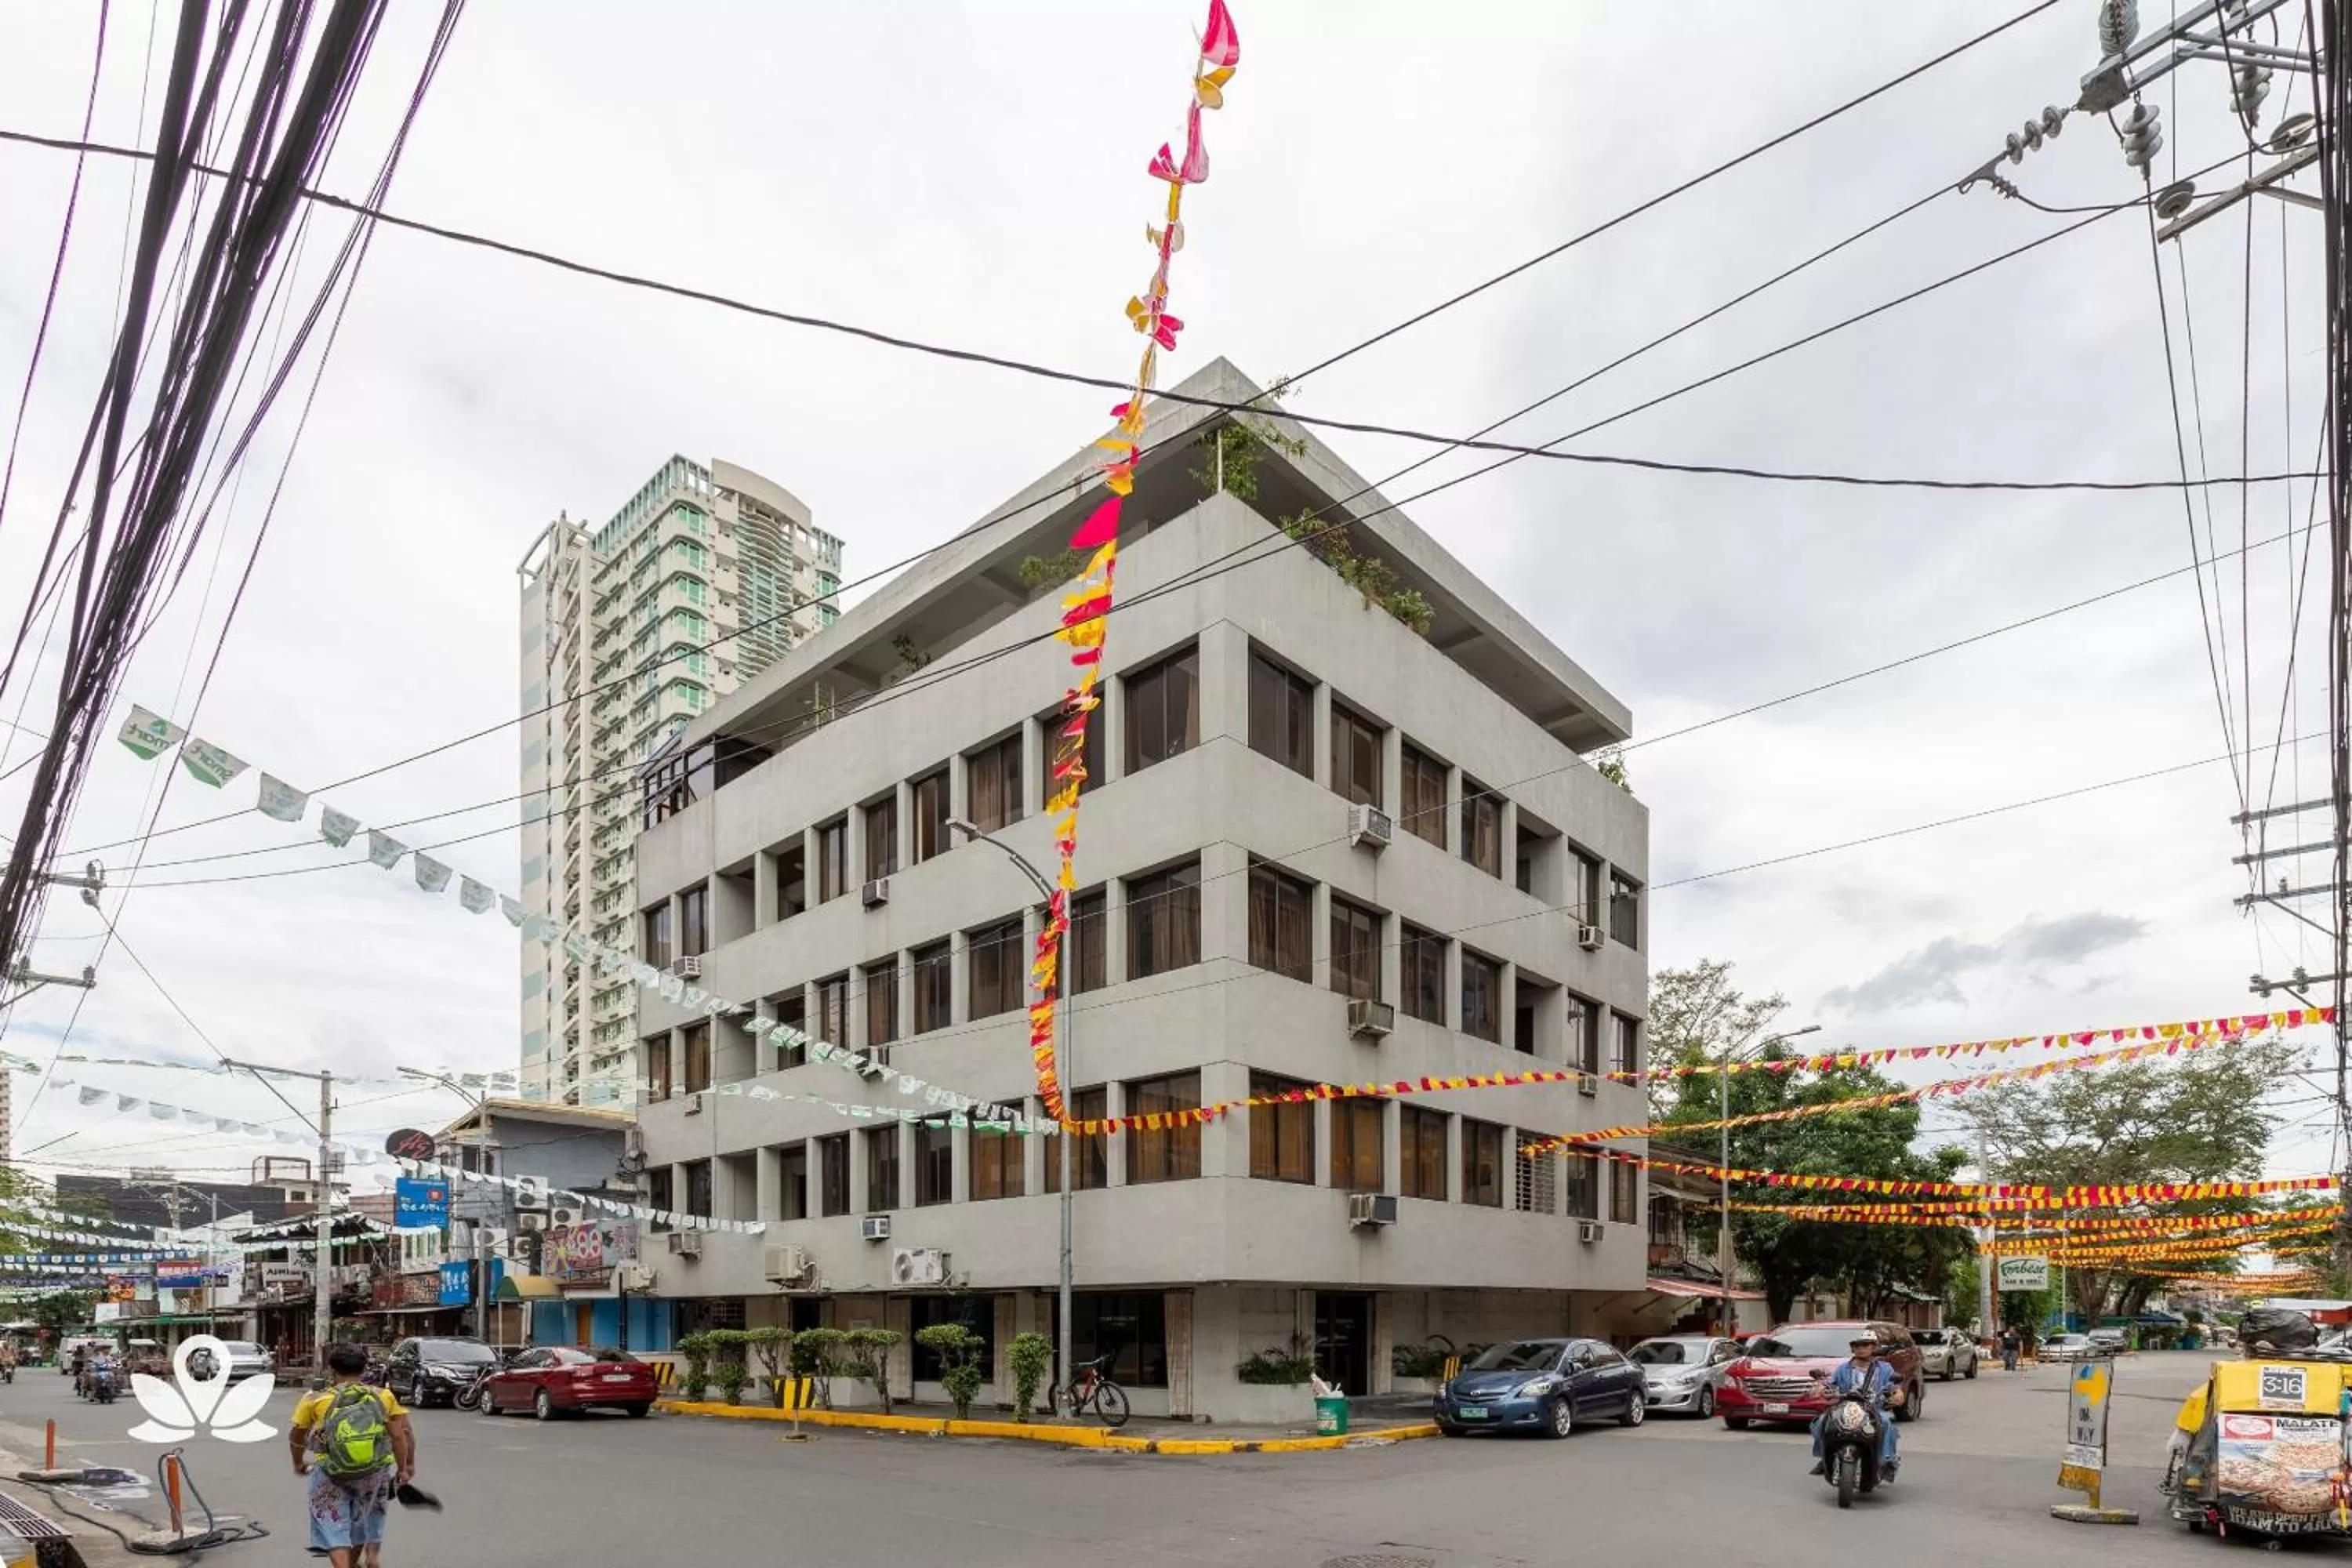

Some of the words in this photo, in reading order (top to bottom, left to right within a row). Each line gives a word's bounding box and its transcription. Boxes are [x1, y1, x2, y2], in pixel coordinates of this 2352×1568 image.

[2263, 1376, 2302, 1395] 3:16
[2079, 1407, 2093, 1422] ON
[2277, 1522, 2300, 1533] TO
